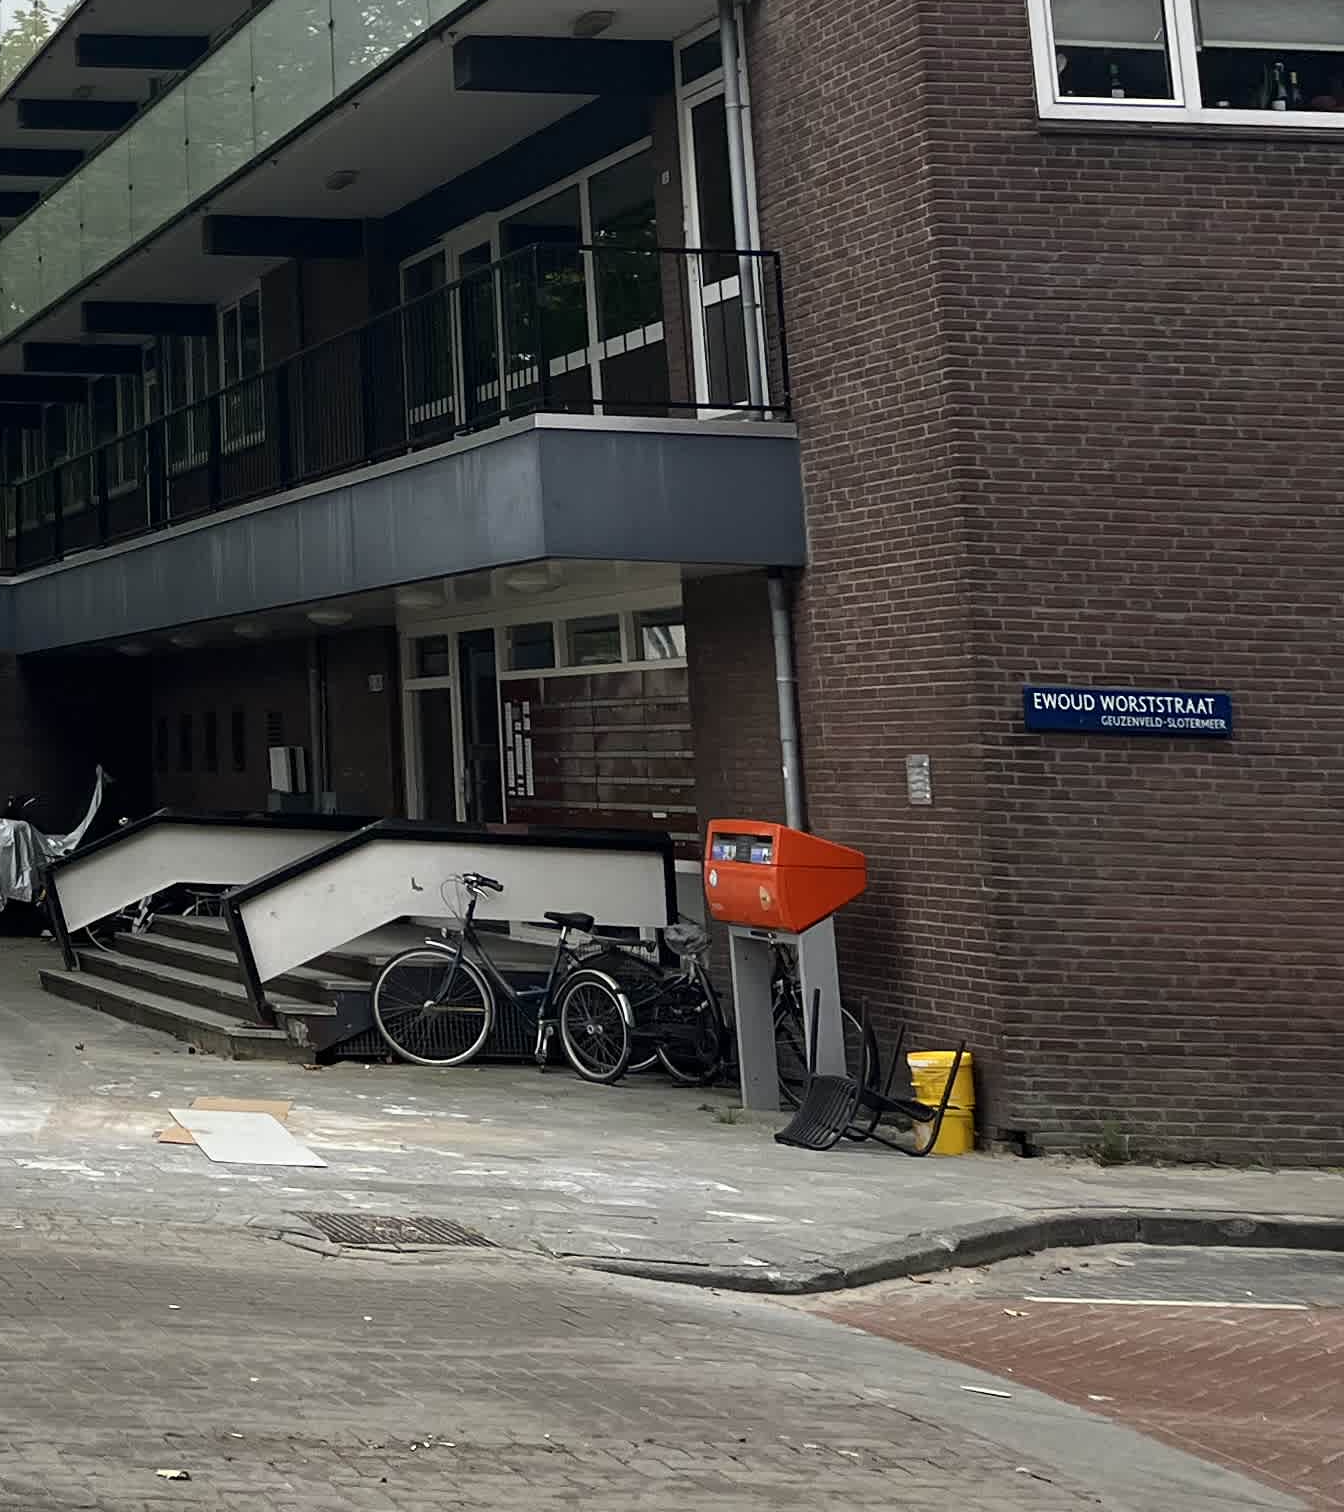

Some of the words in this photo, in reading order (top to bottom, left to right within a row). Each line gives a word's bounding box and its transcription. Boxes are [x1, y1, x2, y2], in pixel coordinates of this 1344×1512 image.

[1033, 692, 1096, 711] EWOUD
[1100, 695, 1215, 715] WORSTSTRAAT
[1100, 715, 1227, 730] GEUZENVELD-SLOTERMEER
